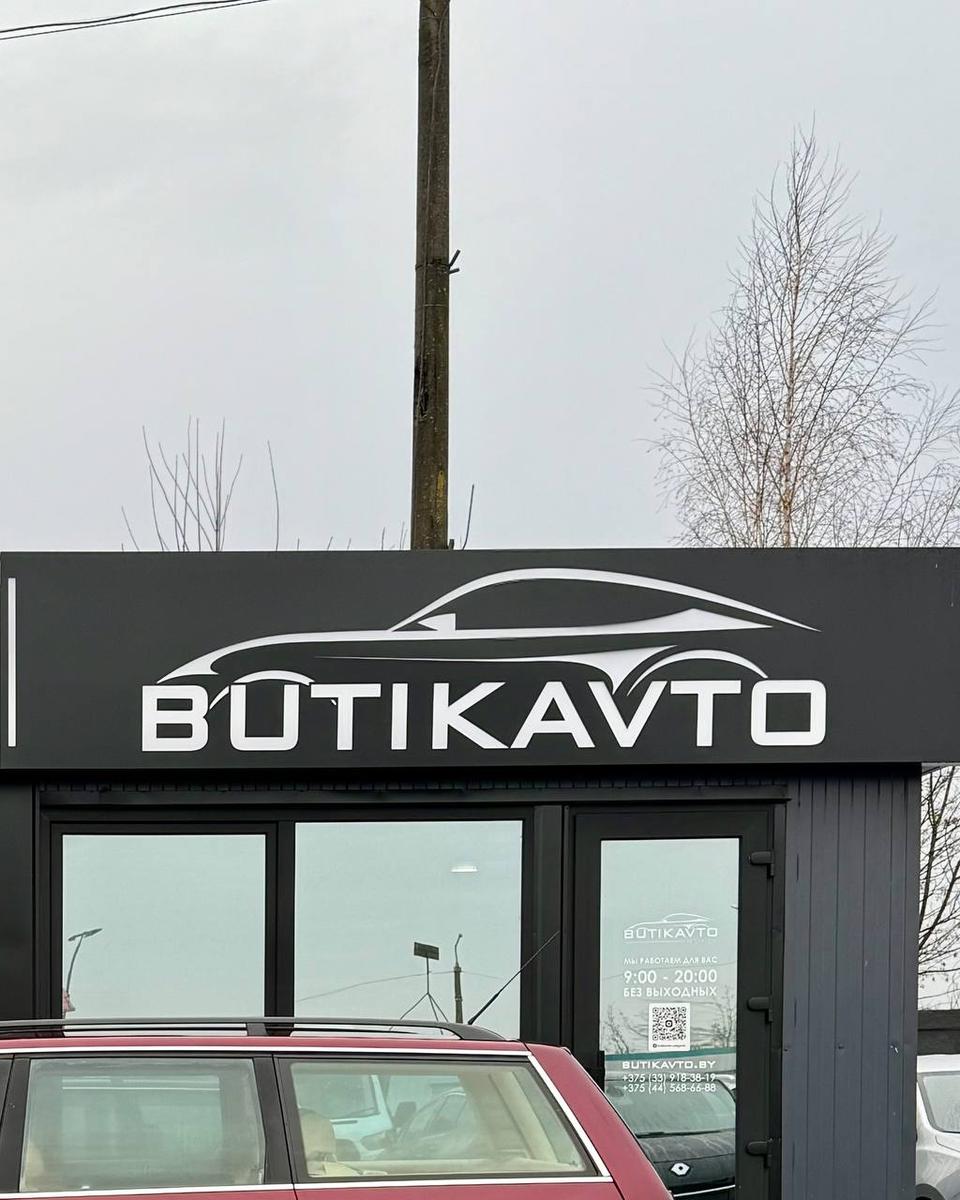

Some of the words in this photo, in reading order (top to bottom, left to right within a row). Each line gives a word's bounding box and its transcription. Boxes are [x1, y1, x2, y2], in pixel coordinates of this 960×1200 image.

[141, 679, 827, 752] BUTIKAVTO
[623, 928, 718, 939] BUTIKAVTO
[624, 970, 657, 984] 9:00
[674, 969, 718, 983] 20:00
[623, 987, 642, 997] БЕЗ
[646, 986, 717, 998] ВЫХОДНЫХ
[622, 1060, 716, 1069] BUTIKAVTO.BY
[623, 1073, 646, 1083] +375
[649, 1073, 666, 1084] (33)
[669, 1073, 716, 1082] 918-38-19
[623, 1083, 646, 1093] +375
[649, 1083, 666, 1094] (44)
[669, 1083, 716, 1093] 568-66-88
